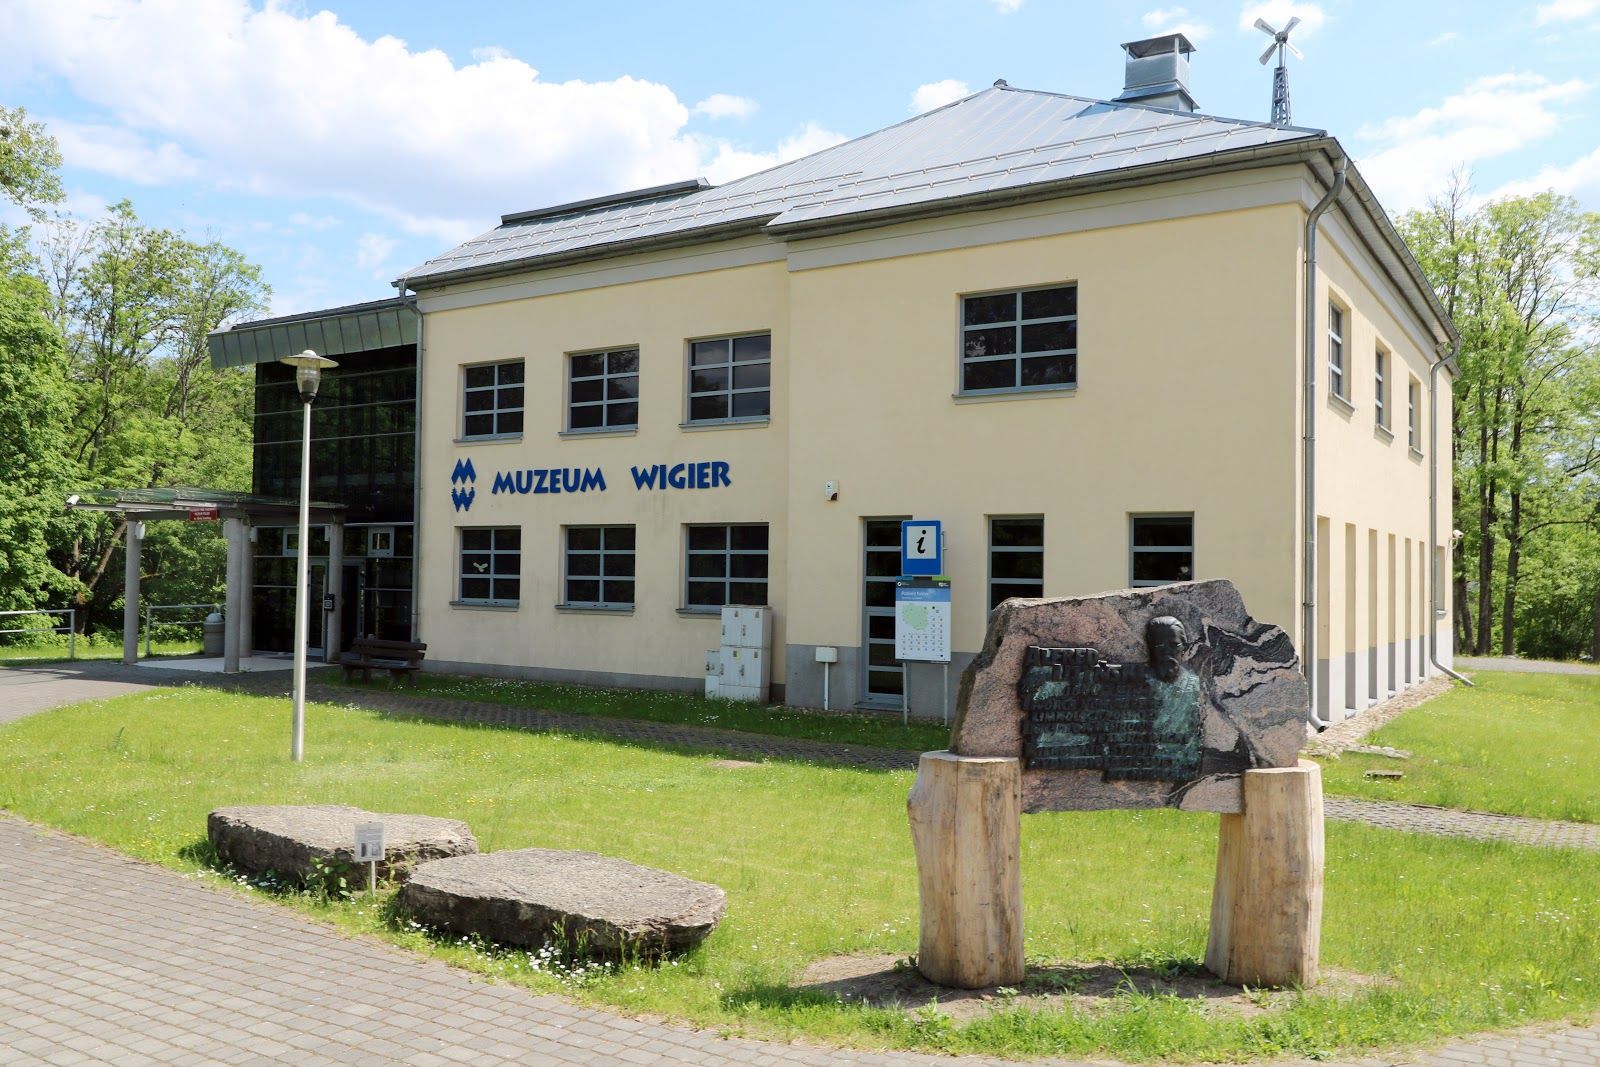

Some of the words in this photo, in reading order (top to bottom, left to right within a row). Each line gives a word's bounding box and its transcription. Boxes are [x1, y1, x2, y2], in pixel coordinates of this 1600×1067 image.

[491, 467, 607, 495] MUZEUM
[631, 461, 732, 491] WIGIER
[1026, 646, 1098, 665] ALFRED
